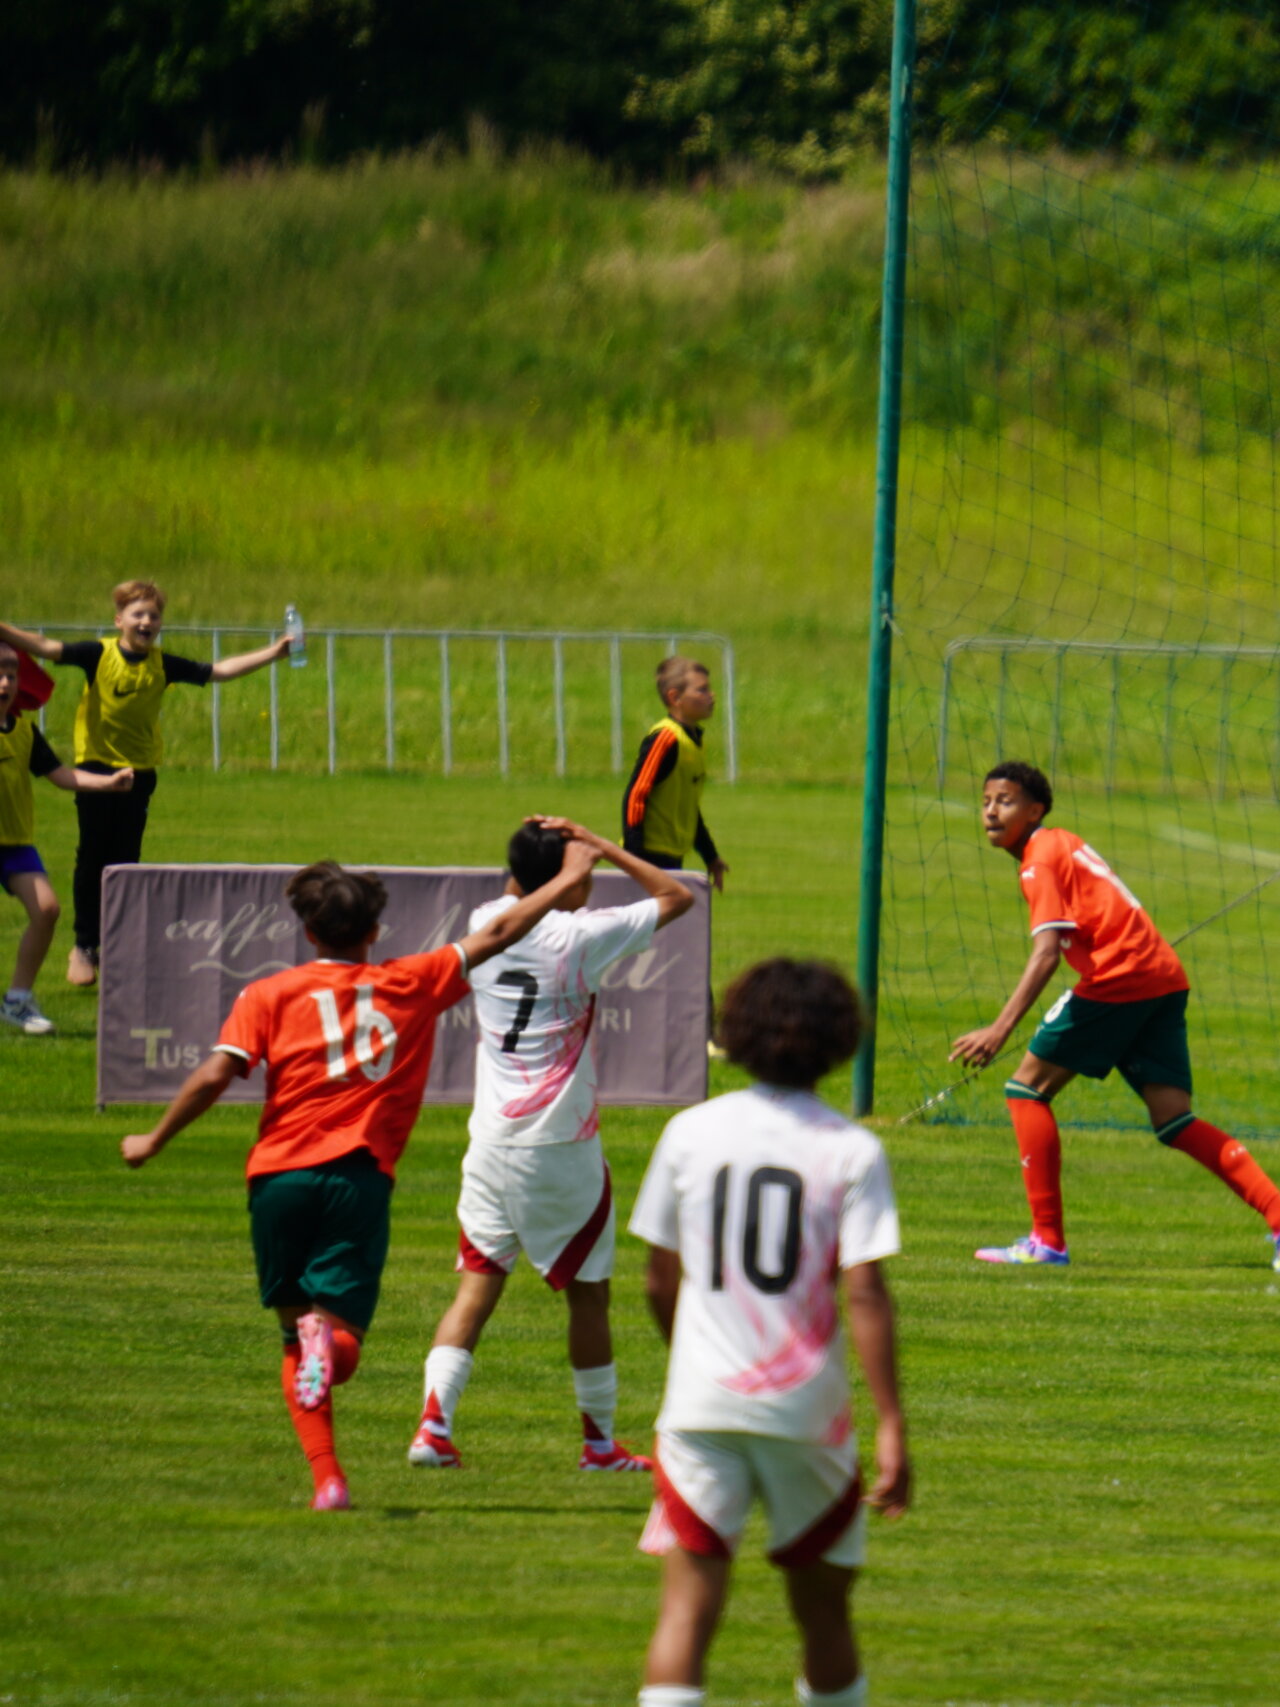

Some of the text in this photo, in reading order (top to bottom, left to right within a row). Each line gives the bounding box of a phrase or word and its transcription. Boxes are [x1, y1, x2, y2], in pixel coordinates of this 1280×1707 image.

[310, 983, 398, 1083] 16
[496, 970, 539, 1053] 7
[711, 1163, 804, 1295] 10
